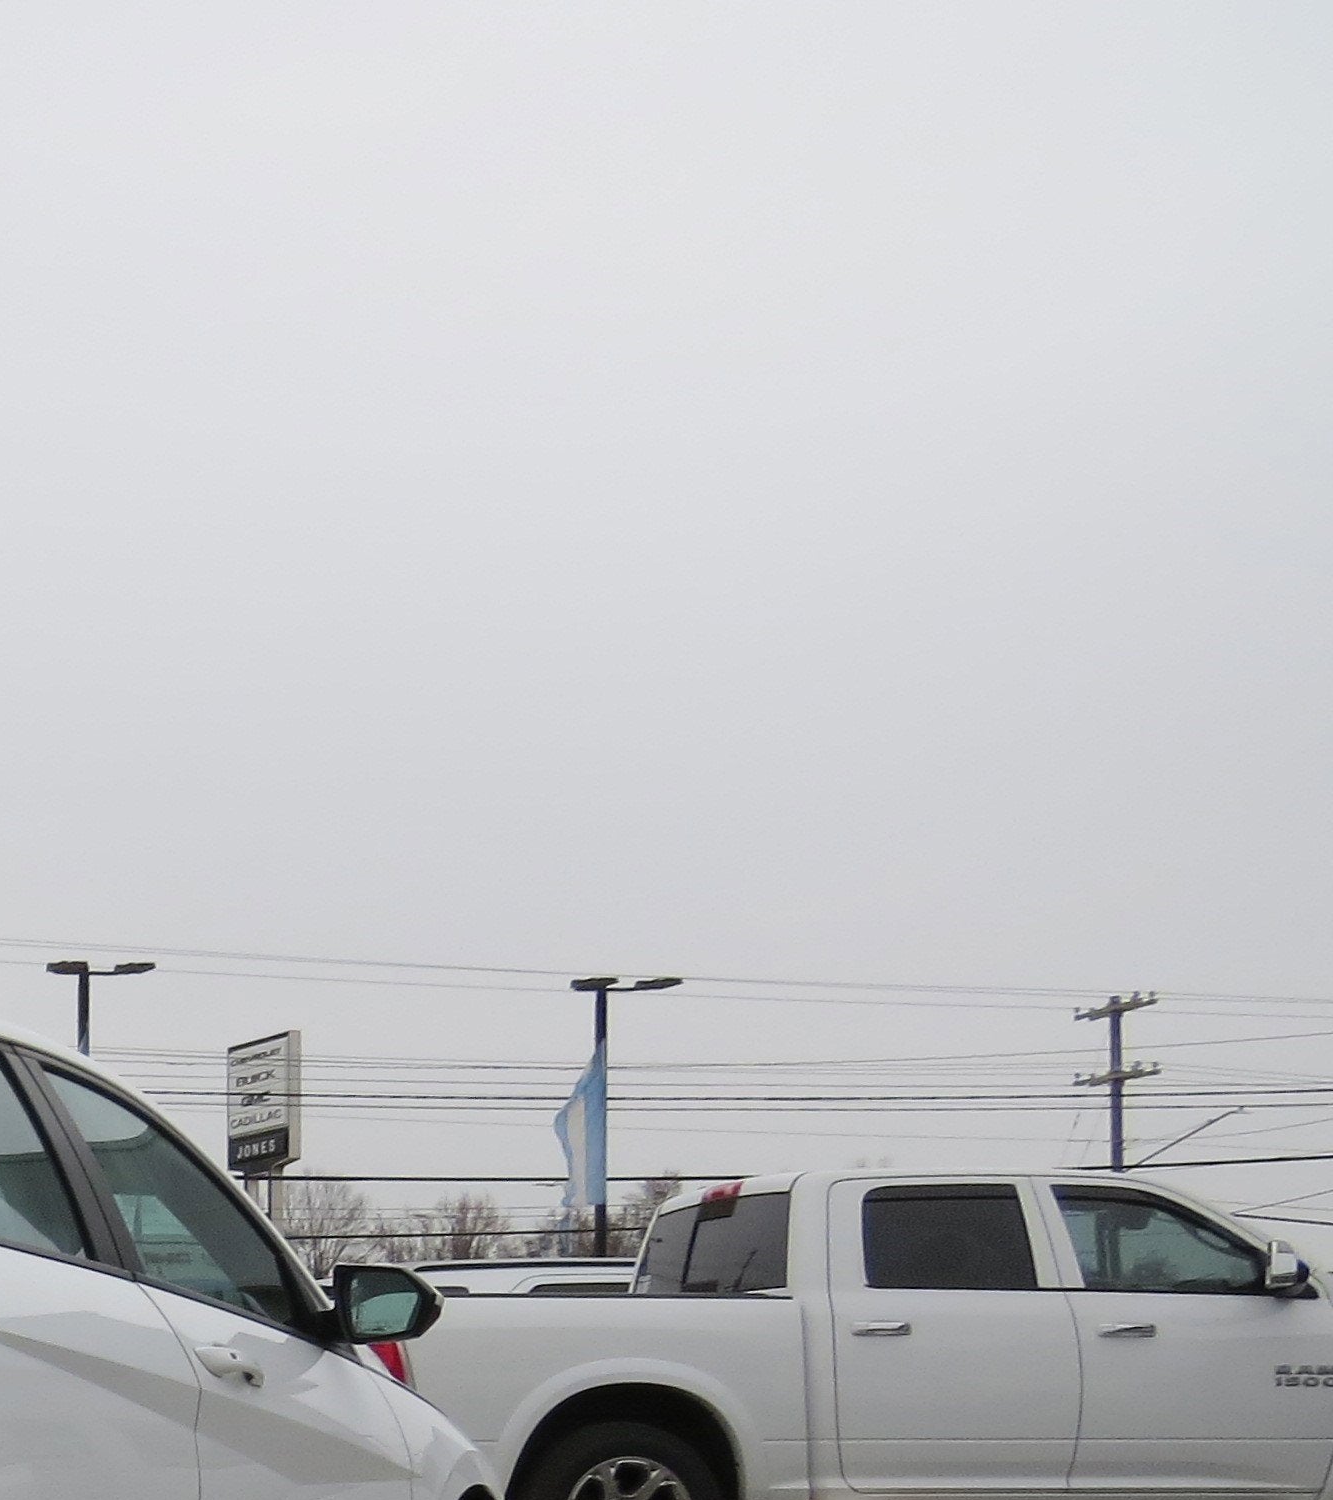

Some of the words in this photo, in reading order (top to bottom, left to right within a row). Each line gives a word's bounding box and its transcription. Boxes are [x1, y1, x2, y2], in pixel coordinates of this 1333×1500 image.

[236, 1069, 276, 1087] BUICK
[231, 1109, 282, 1129] CADILLAC
[236, 1138, 276, 1159] JONES
